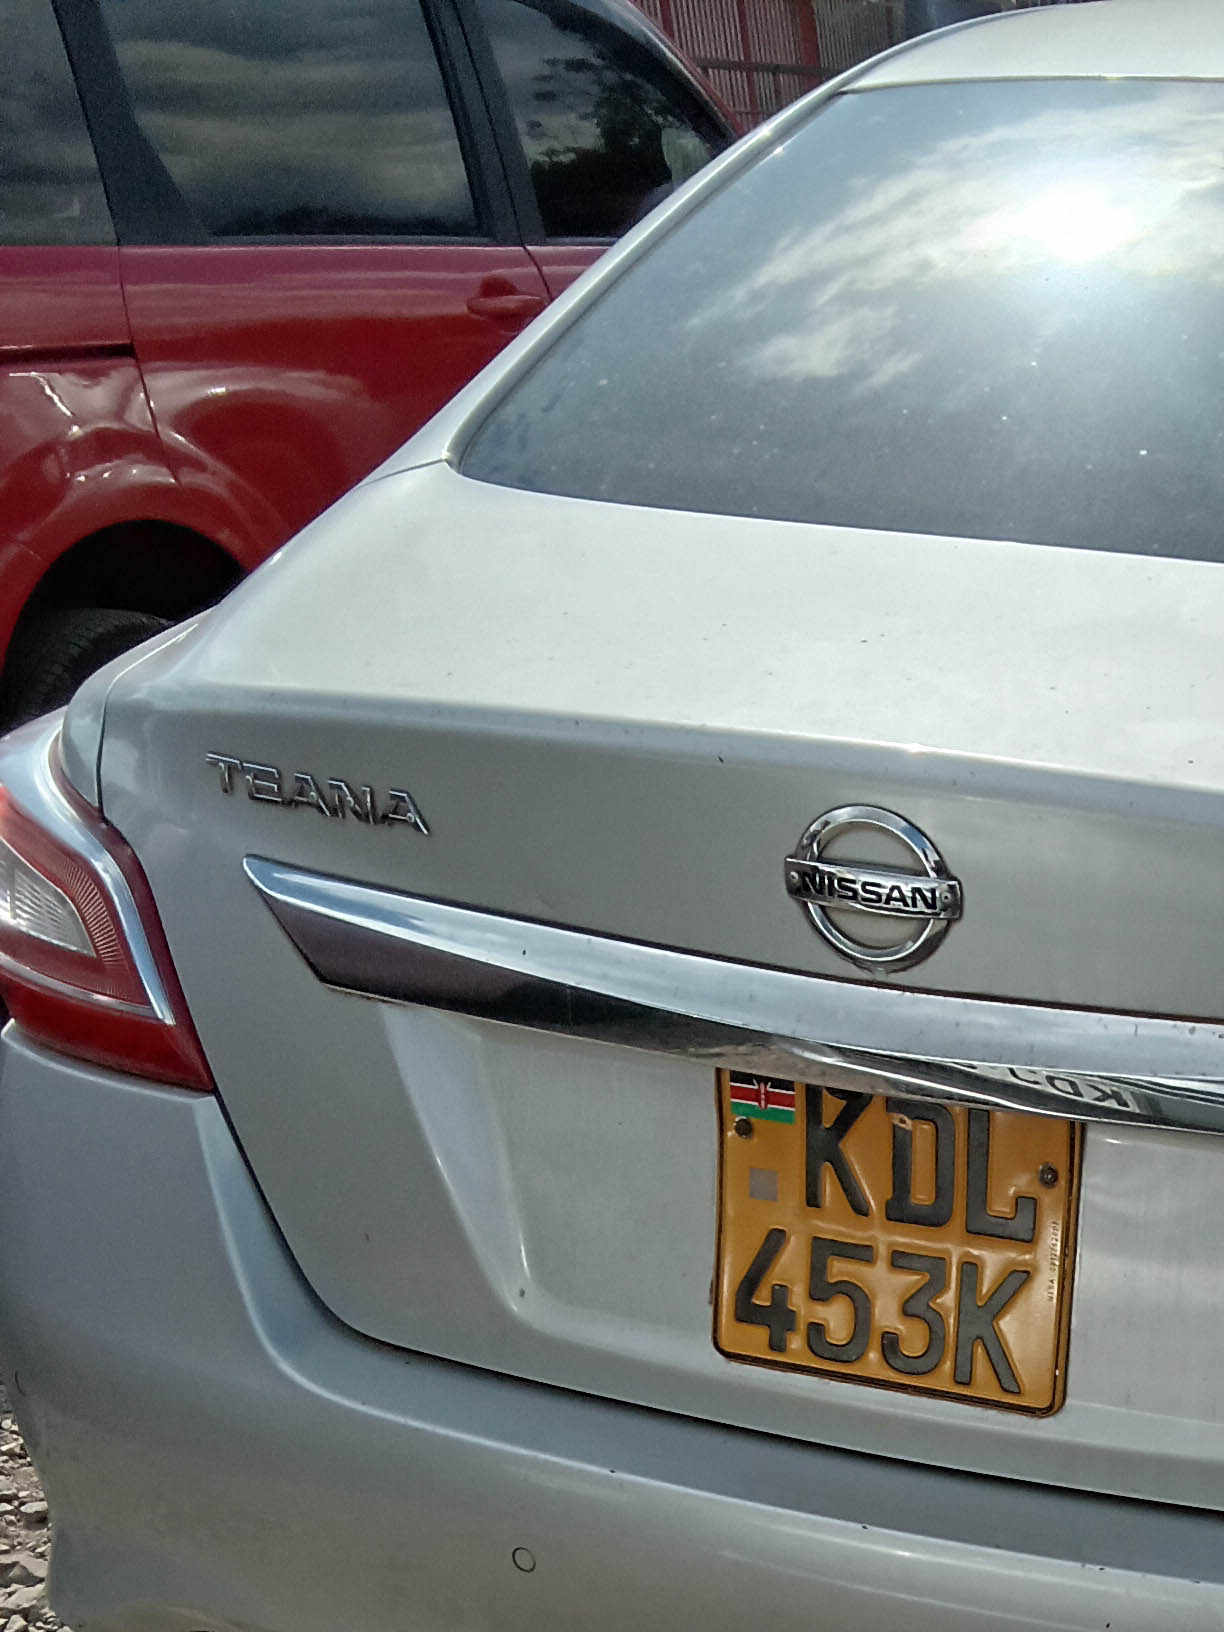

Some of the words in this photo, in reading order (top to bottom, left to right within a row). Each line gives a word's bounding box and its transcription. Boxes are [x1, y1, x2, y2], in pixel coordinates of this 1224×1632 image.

[205, 751, 431, 836] TEANA
[801, 869, 937, 911] NISSAN
[805, 1085, 1038, 1243] KDL
[735, 1228, 1021, 1394] 453K
